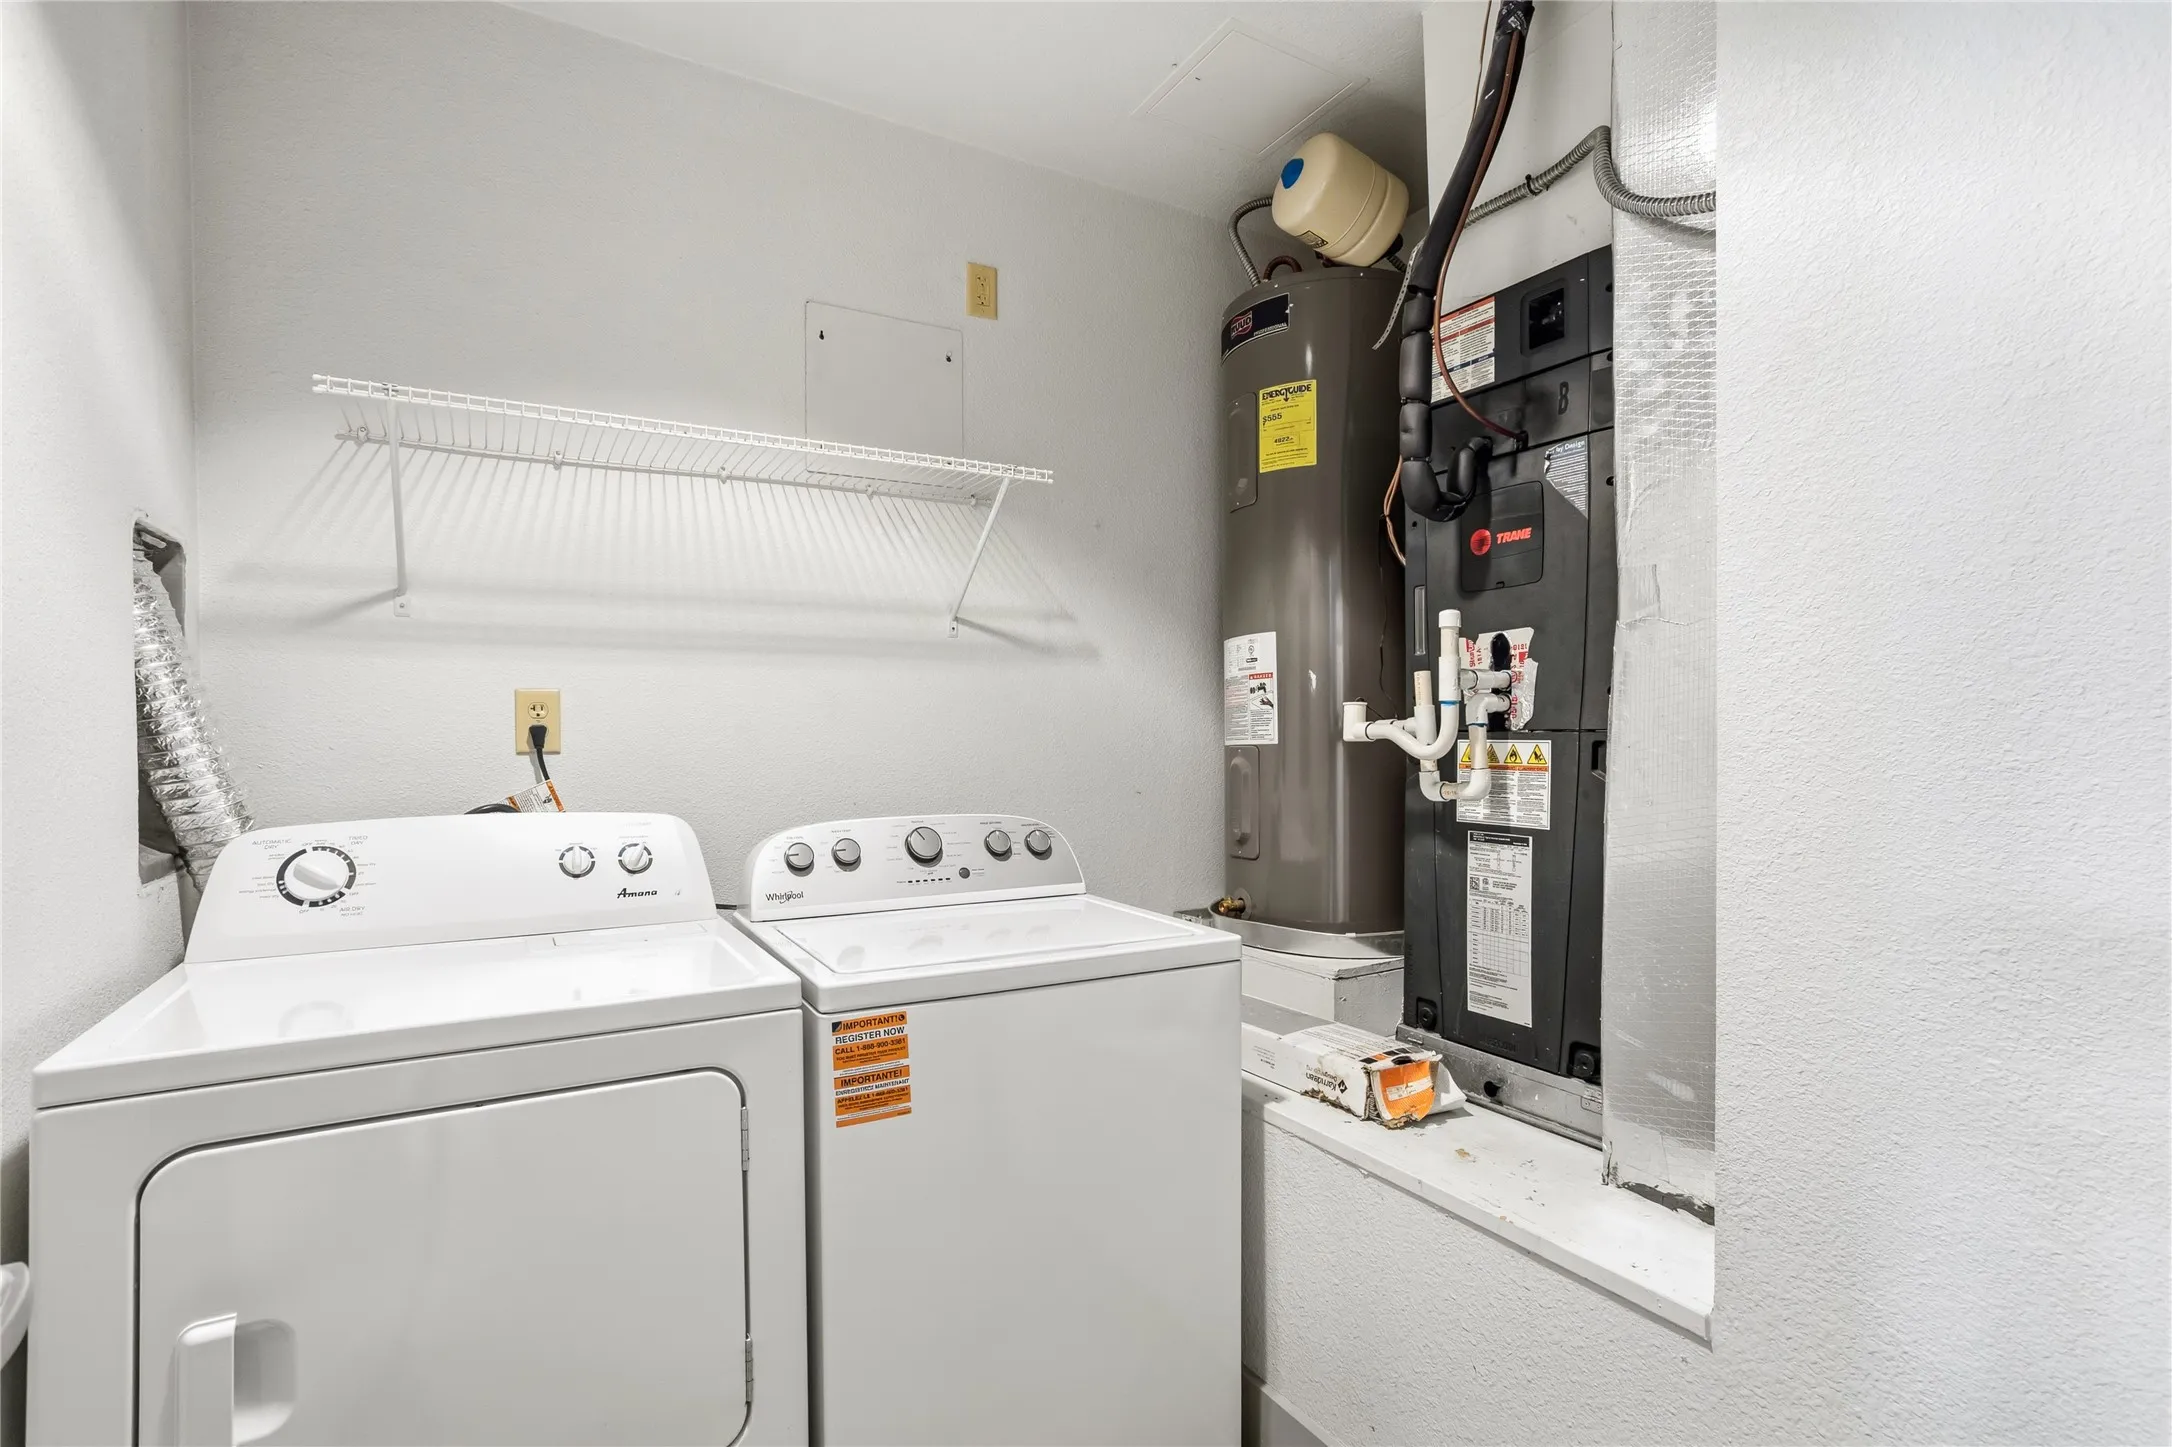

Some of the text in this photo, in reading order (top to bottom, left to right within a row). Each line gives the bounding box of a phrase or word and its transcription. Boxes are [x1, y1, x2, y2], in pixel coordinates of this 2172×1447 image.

[1262, 412, 1283, 424] $555
[1496, 527, 1532, 544] TRANE
[617, 888, 658, 899] Amana
[765, 890, 804, 904] Whirlpool
[842, 1015, 898, 1031] IMPORTANT!
[835, 1026, 905, 1045] REGISTER NOW
[835, 1047, 855, 1055] CALL
[1305, 1072, 1337, 1092] Karndean
